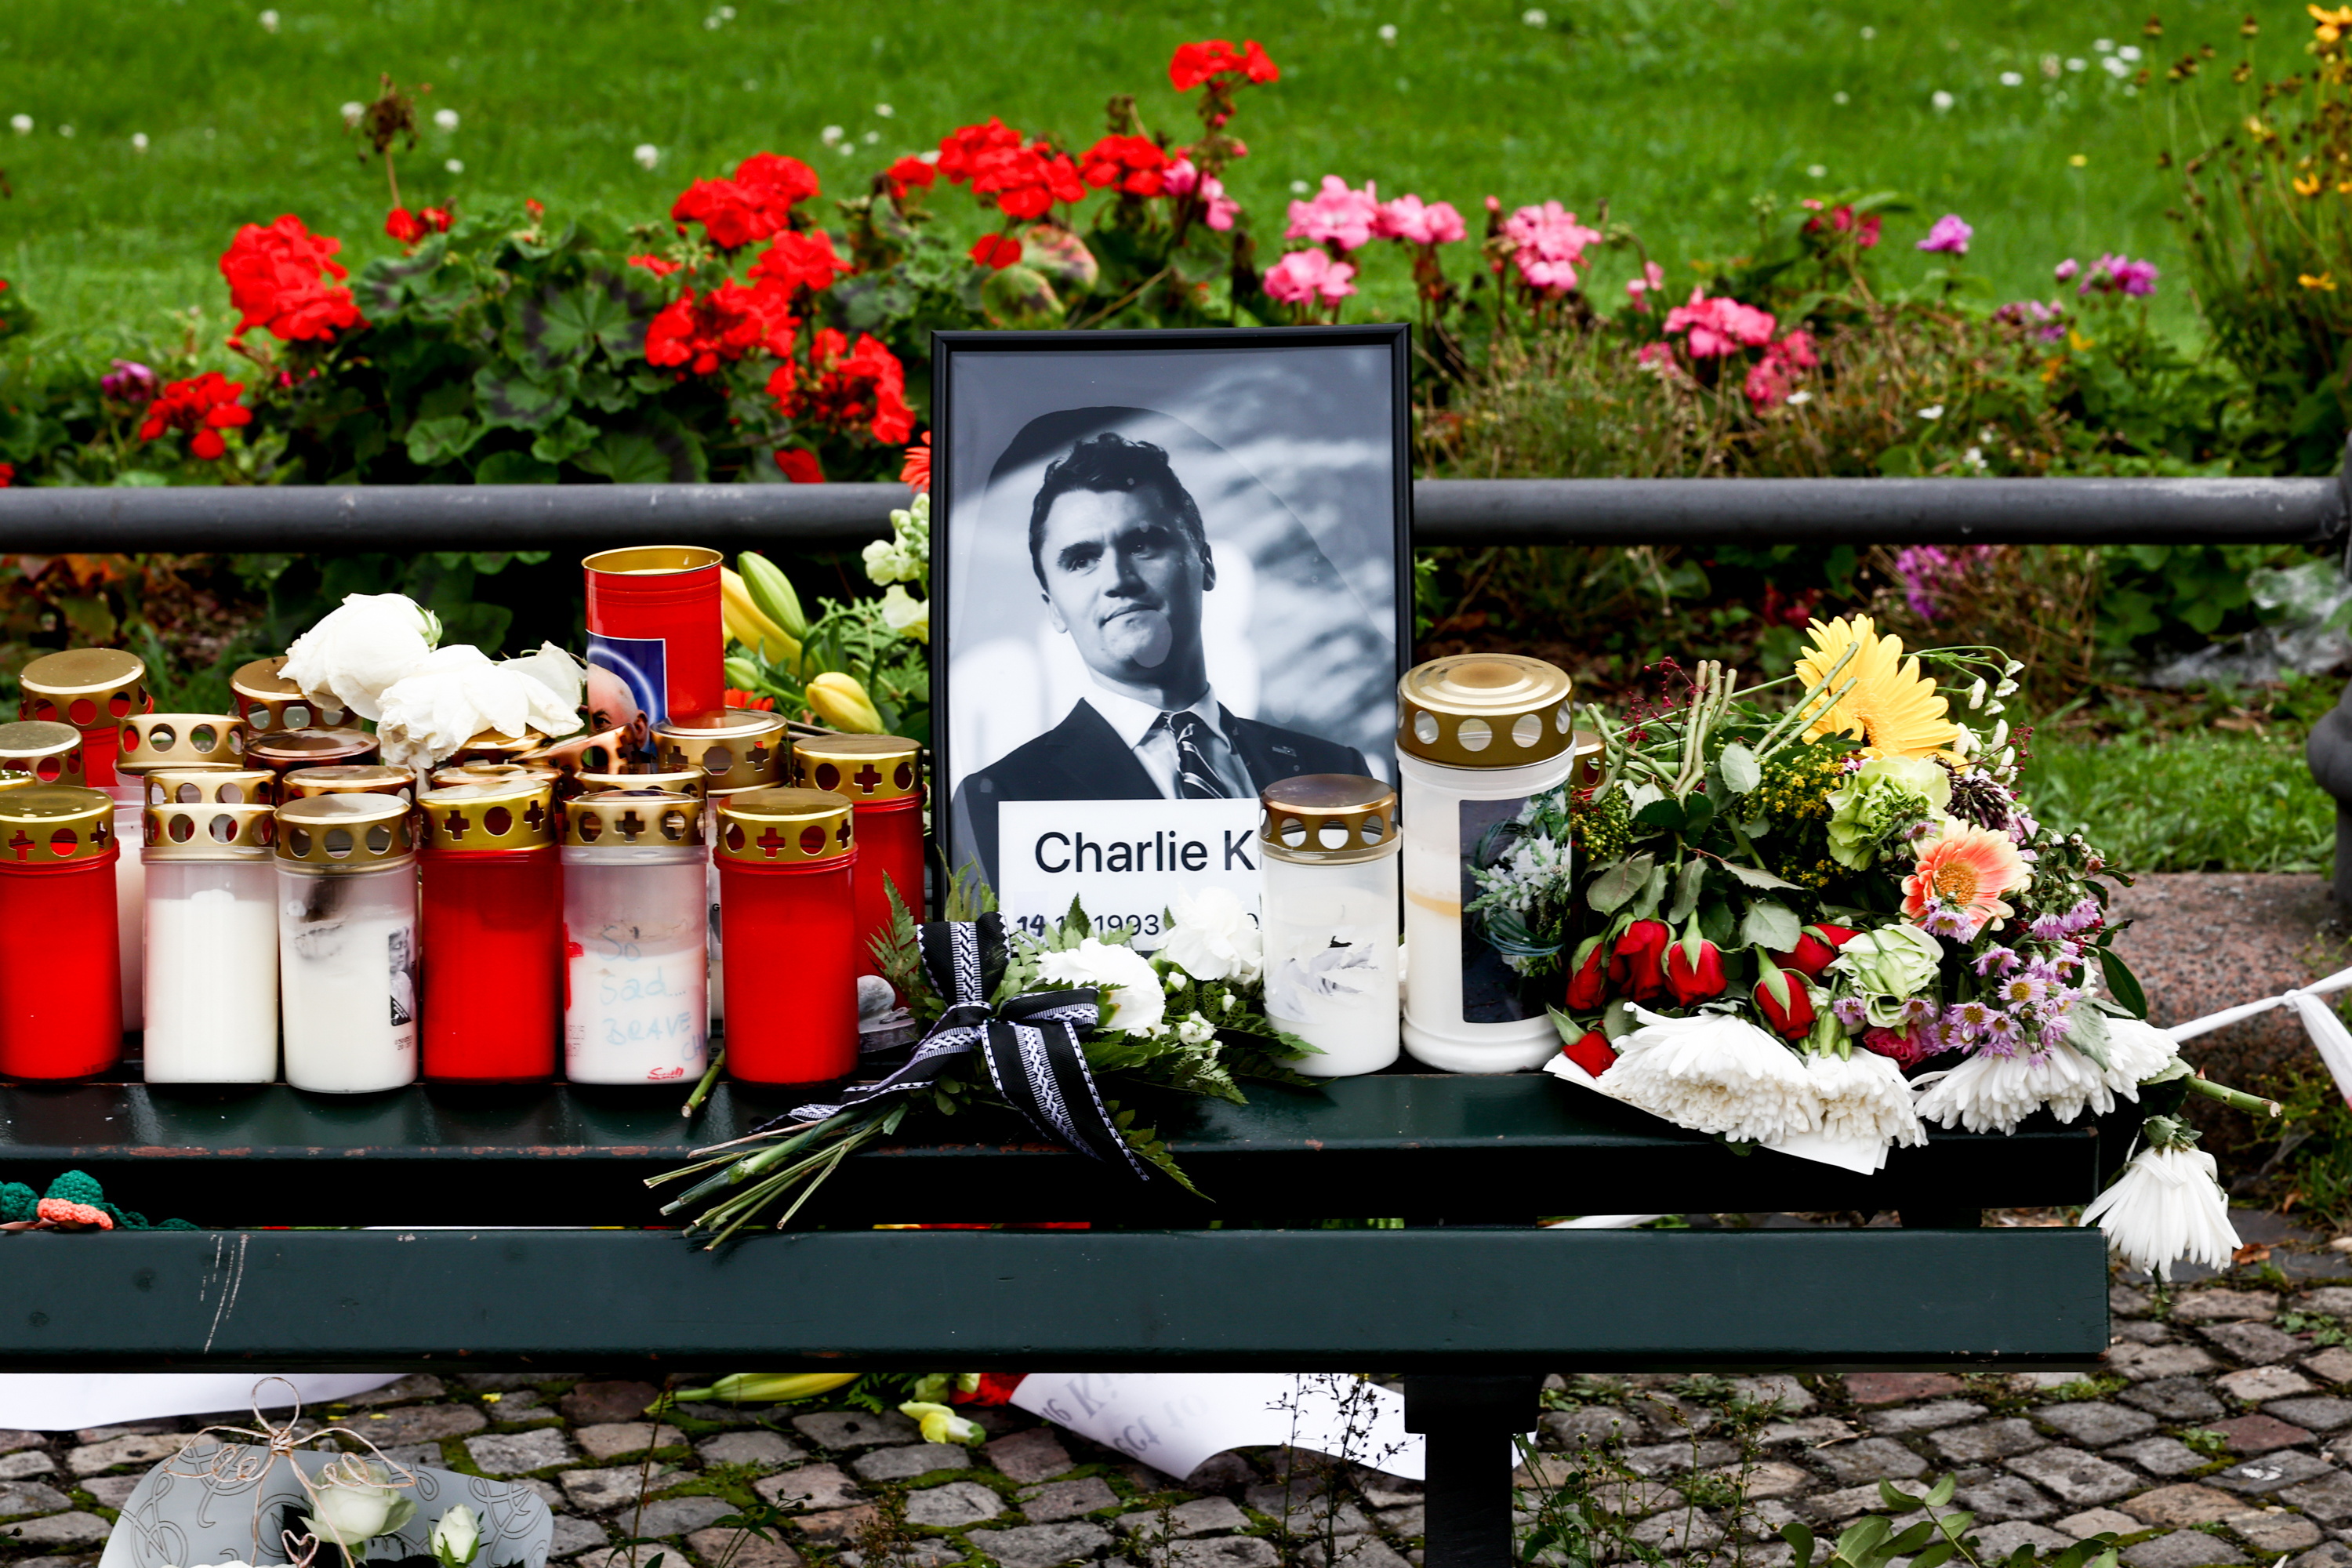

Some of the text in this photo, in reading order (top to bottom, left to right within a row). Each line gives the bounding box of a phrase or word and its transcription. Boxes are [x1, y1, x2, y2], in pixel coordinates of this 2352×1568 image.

[1035, 829, 1261, 873] Charlie K
[598, 925, 641, 961] So
